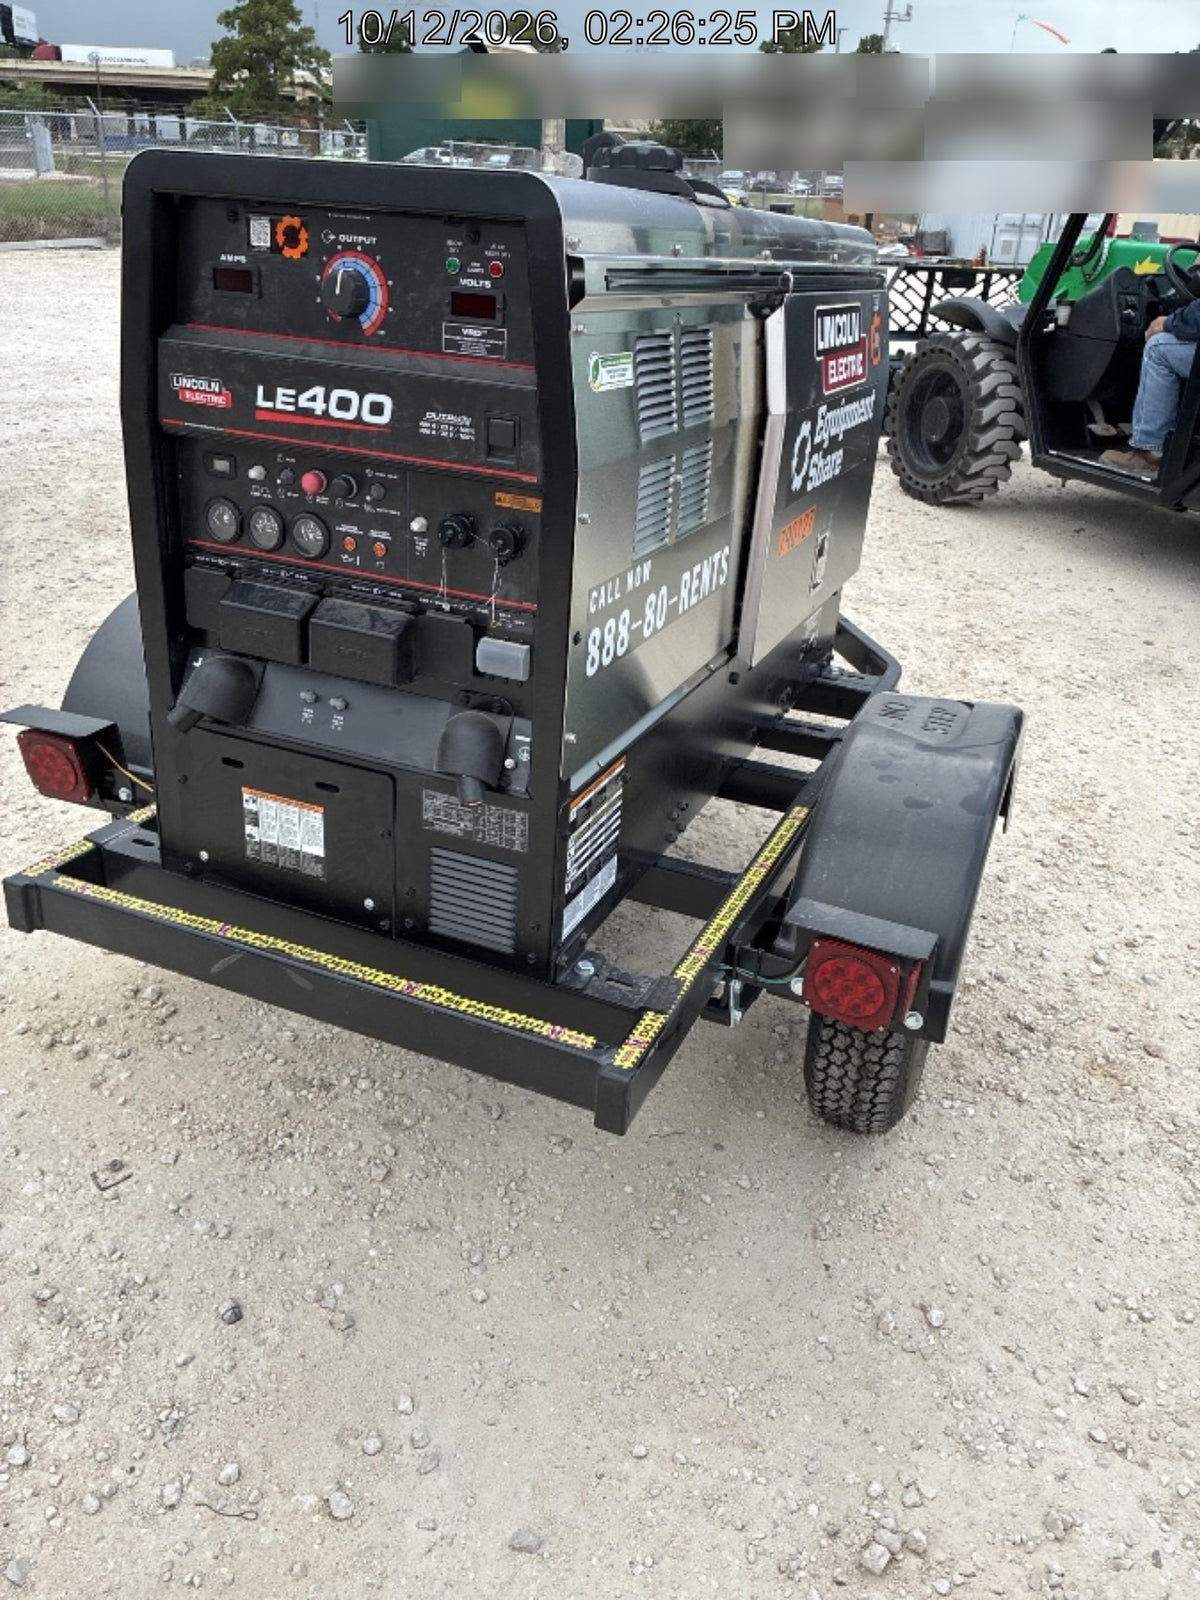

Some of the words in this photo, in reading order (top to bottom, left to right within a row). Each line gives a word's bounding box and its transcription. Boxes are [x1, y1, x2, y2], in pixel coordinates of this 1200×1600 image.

[339, 234, 377, 244] OUTPUT
[220, 254, 247, 263] AMPS
[459, 278, 491, 288] VOLTS
[817, 312, 860, 350] LINCOLN
[173, 376, 219, 393] LINCOLN
[828, 353, 863, 385] ELECTRIC
[184, 391, 227, 405] ELECTRIC
[256, 384, 393, 425] LE400
[814, 389, 875, 448] Equipment
[807, 448, 844, 492] Share
[589, 577, 621, 614] CALL
[626, 559, 652, 592] NOW
[586, 545, 730, 677] 888-80-RENTS
[420, 986, 442, 1000] NO
